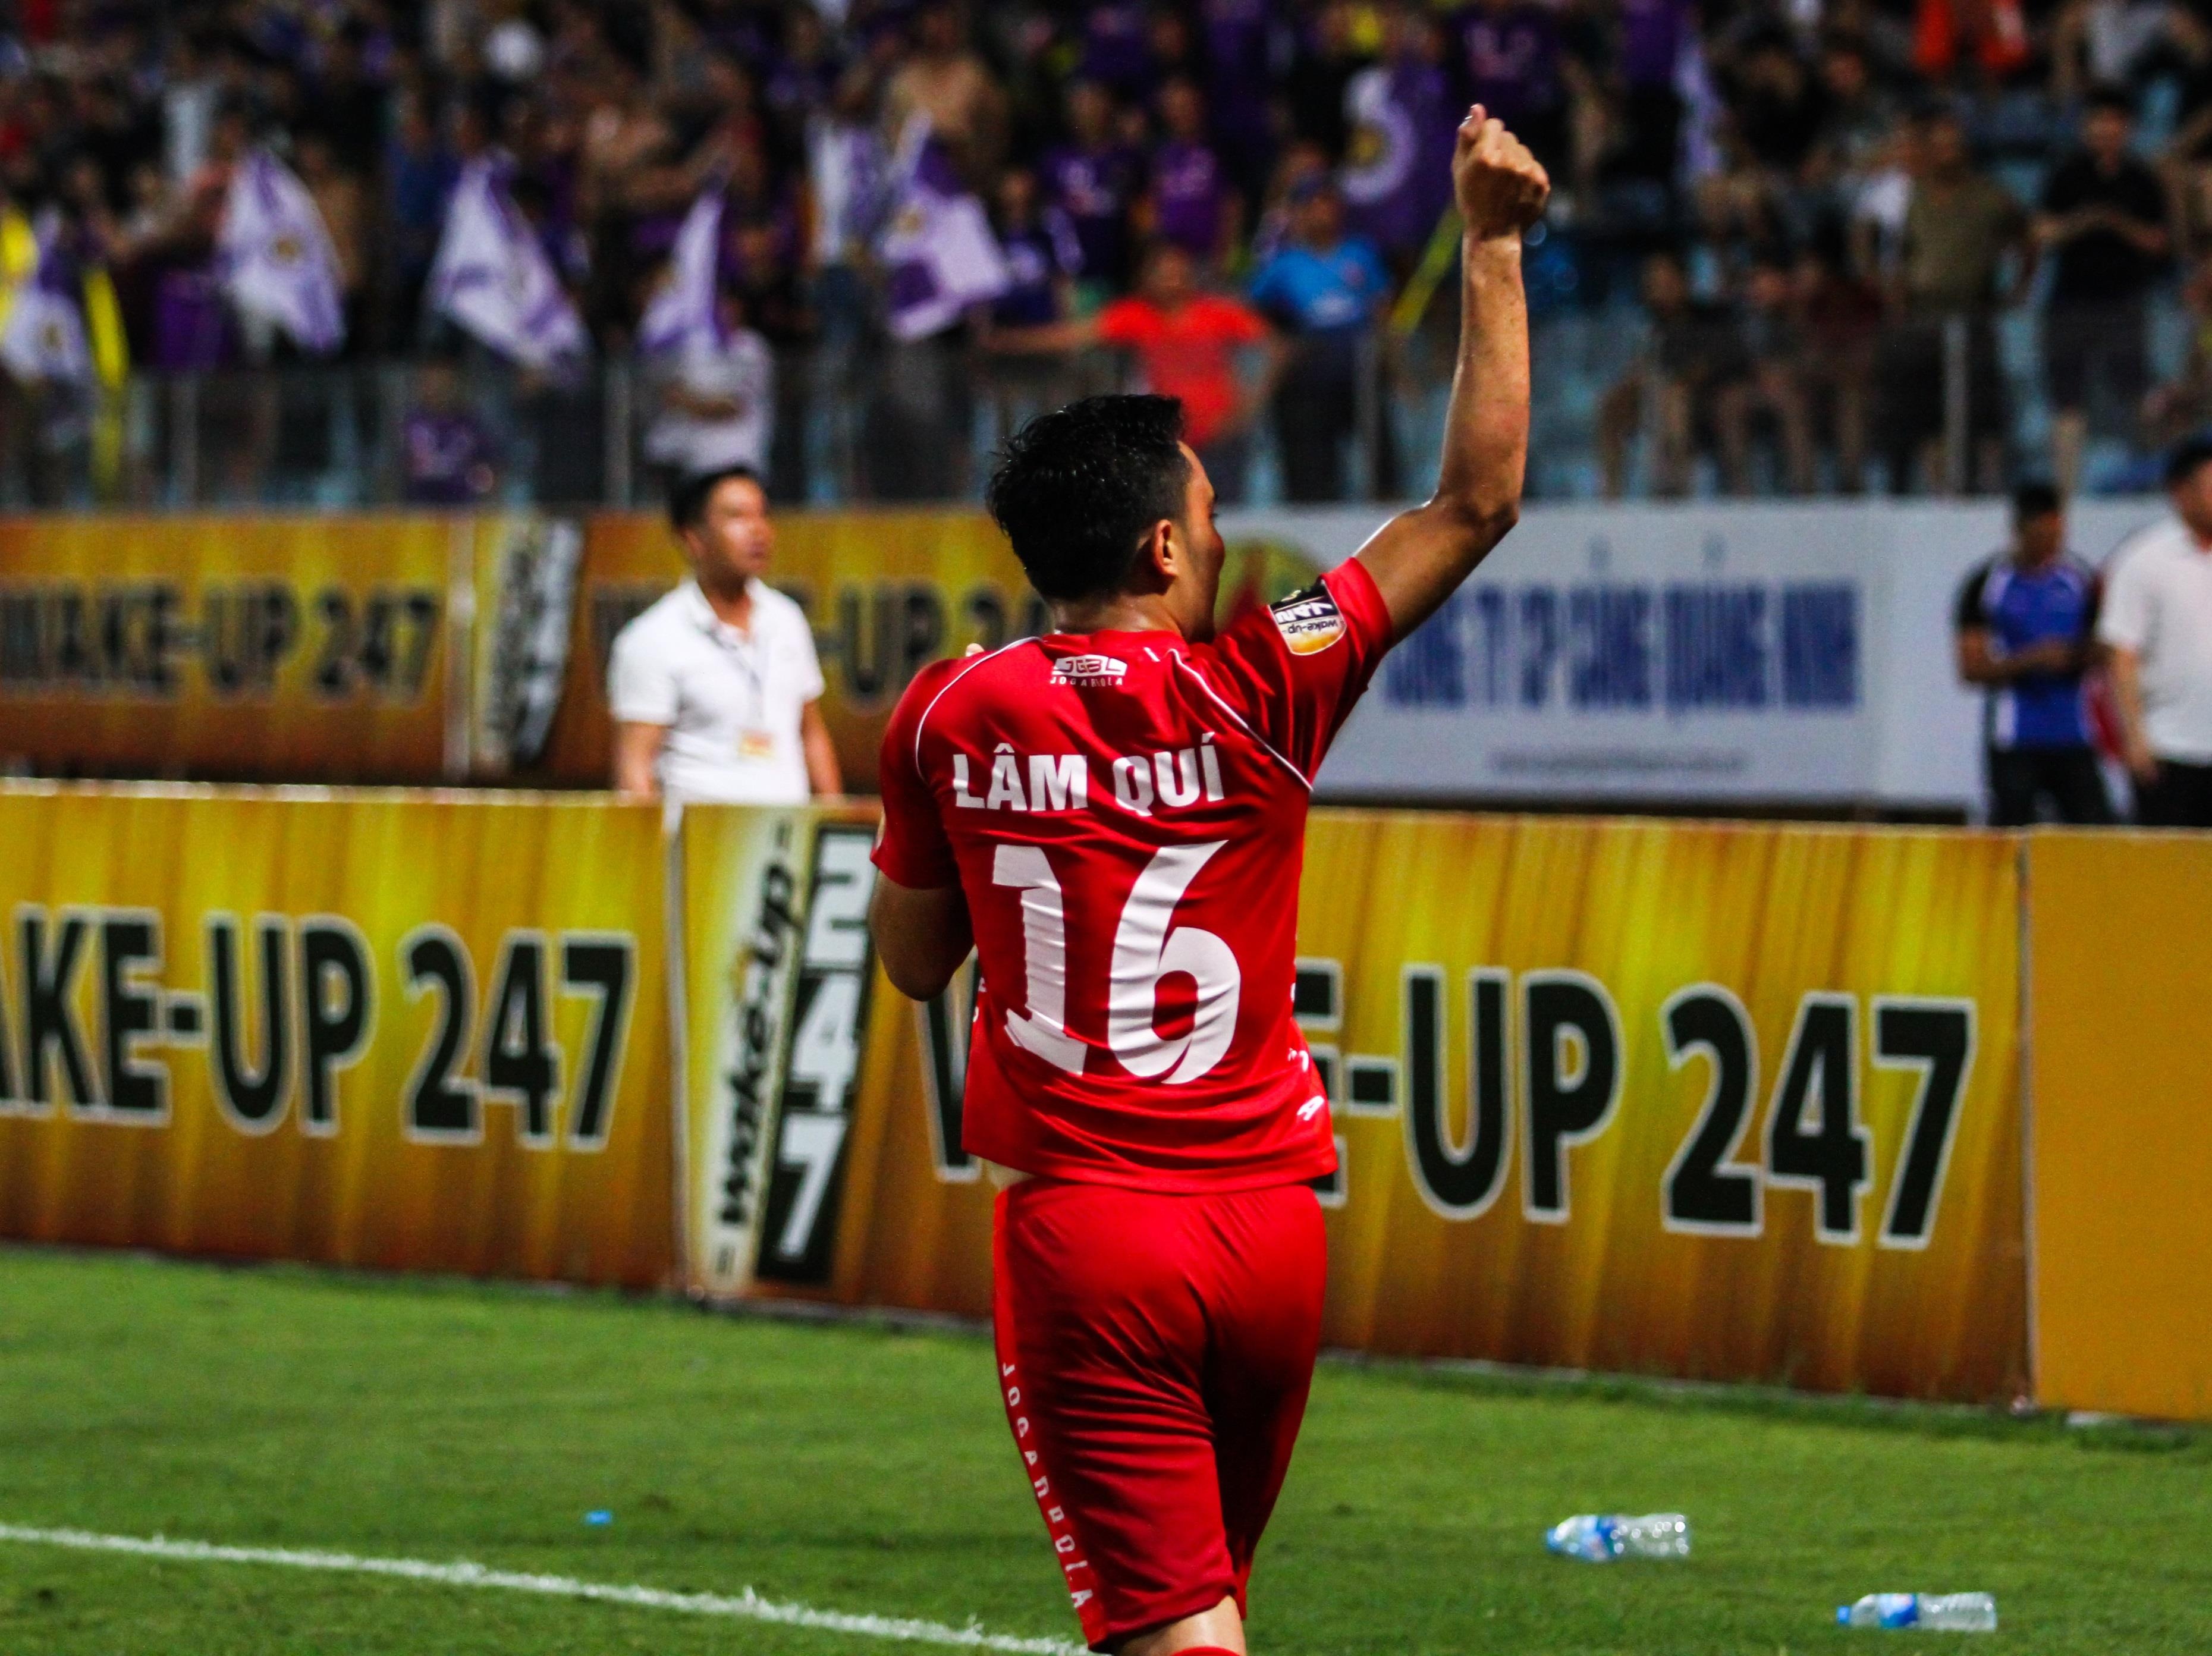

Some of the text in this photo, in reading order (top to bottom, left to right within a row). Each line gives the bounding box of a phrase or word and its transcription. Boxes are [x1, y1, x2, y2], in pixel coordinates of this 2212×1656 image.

[1287, 619, 1338, 634] wake-up
[953, 731, 1226, 816] LÂM QUÍ
[397, 922, 639, 1152] 247
[992, 840, 1241, 1084] 16
[1660, 981, 1977, 1250] 247
